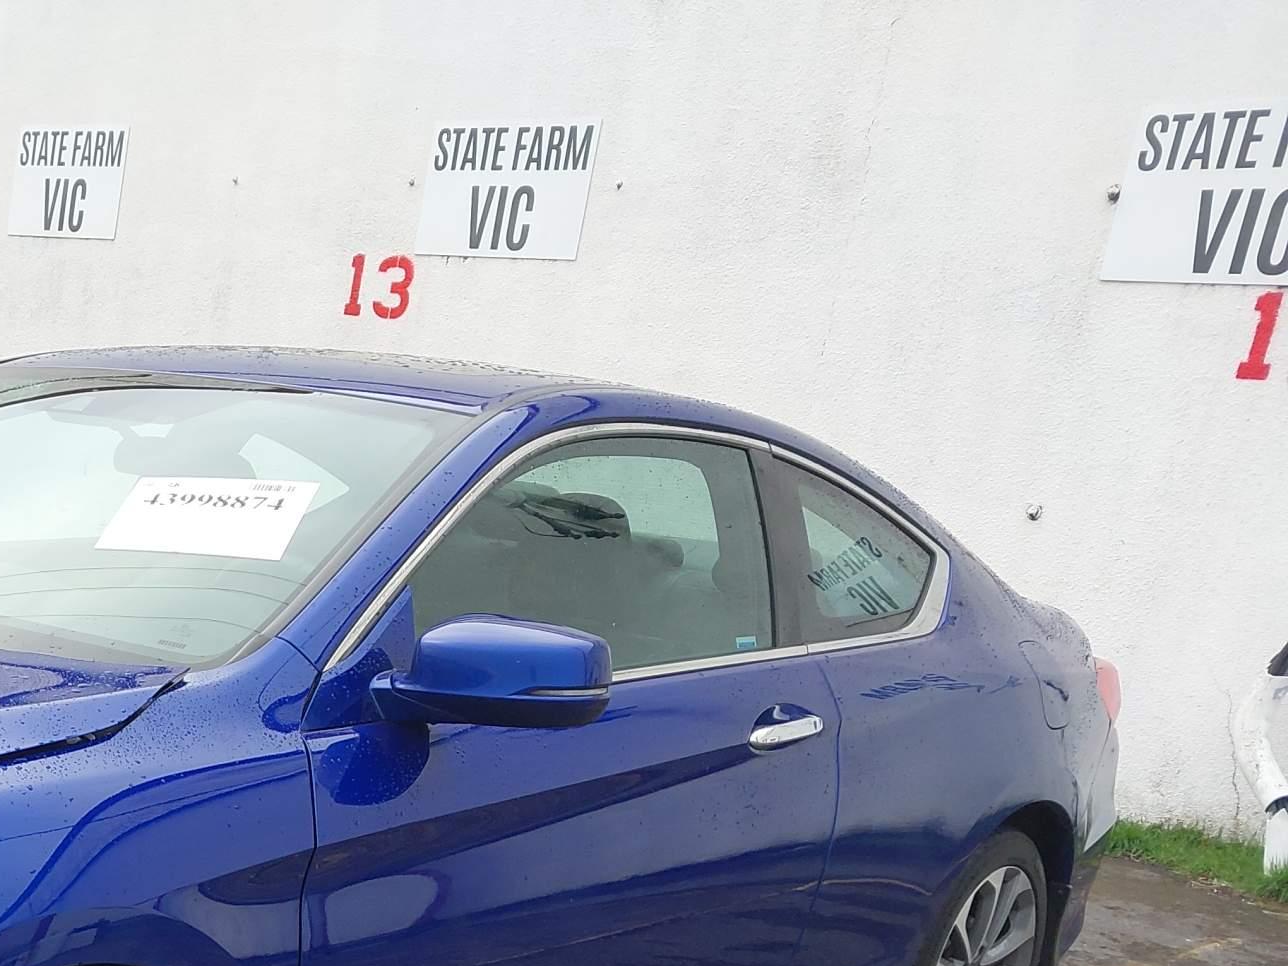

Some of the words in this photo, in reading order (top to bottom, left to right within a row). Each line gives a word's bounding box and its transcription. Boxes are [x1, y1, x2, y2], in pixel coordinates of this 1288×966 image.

[20, 130, 69, 167] STATE
[72, 130, 125, 168] FARM
[434, 127, 509, 172] STATE
[512, 125, 595, 171] FARM
[1137, 108, 1272, 172] STATE
[44, 178, 87, 233] VIC
[469, 185, 535, 251] VIC
[343, 253, 416, 320] 13
[144, 493, 285, 511] 43998874
